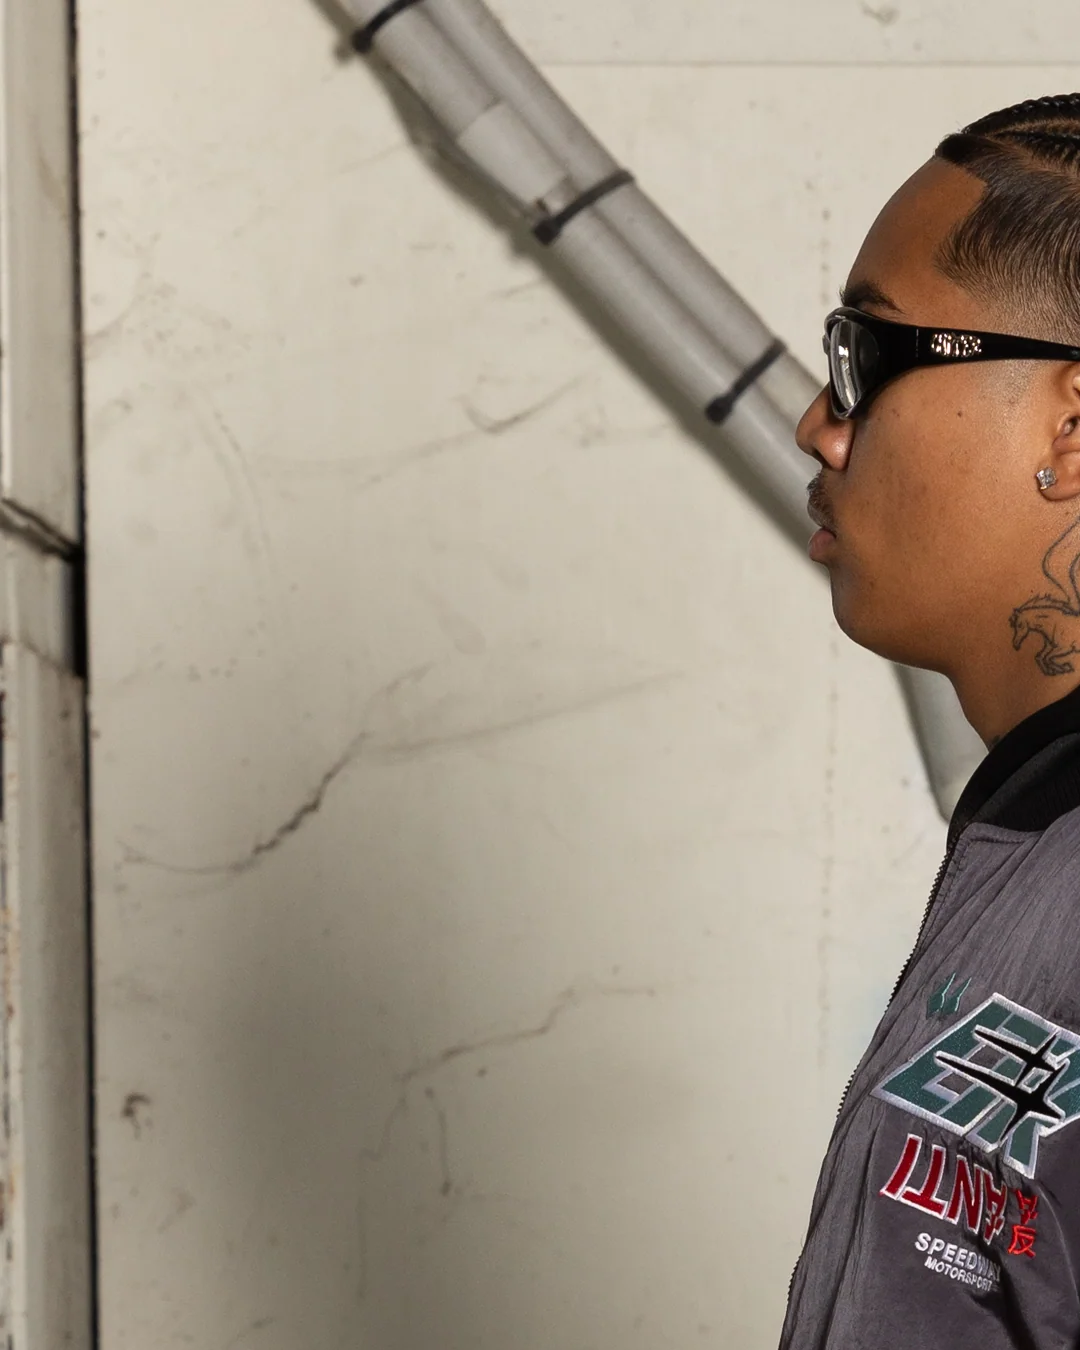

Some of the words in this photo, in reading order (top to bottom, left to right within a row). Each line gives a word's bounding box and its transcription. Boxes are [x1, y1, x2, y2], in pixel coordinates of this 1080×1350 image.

[880, 1132, 1007, 1245] ANTI
[914, 1232, 1002, 1283] SPEEDWAY
[923, 1255, 994, 1292] MOTORSPORT
